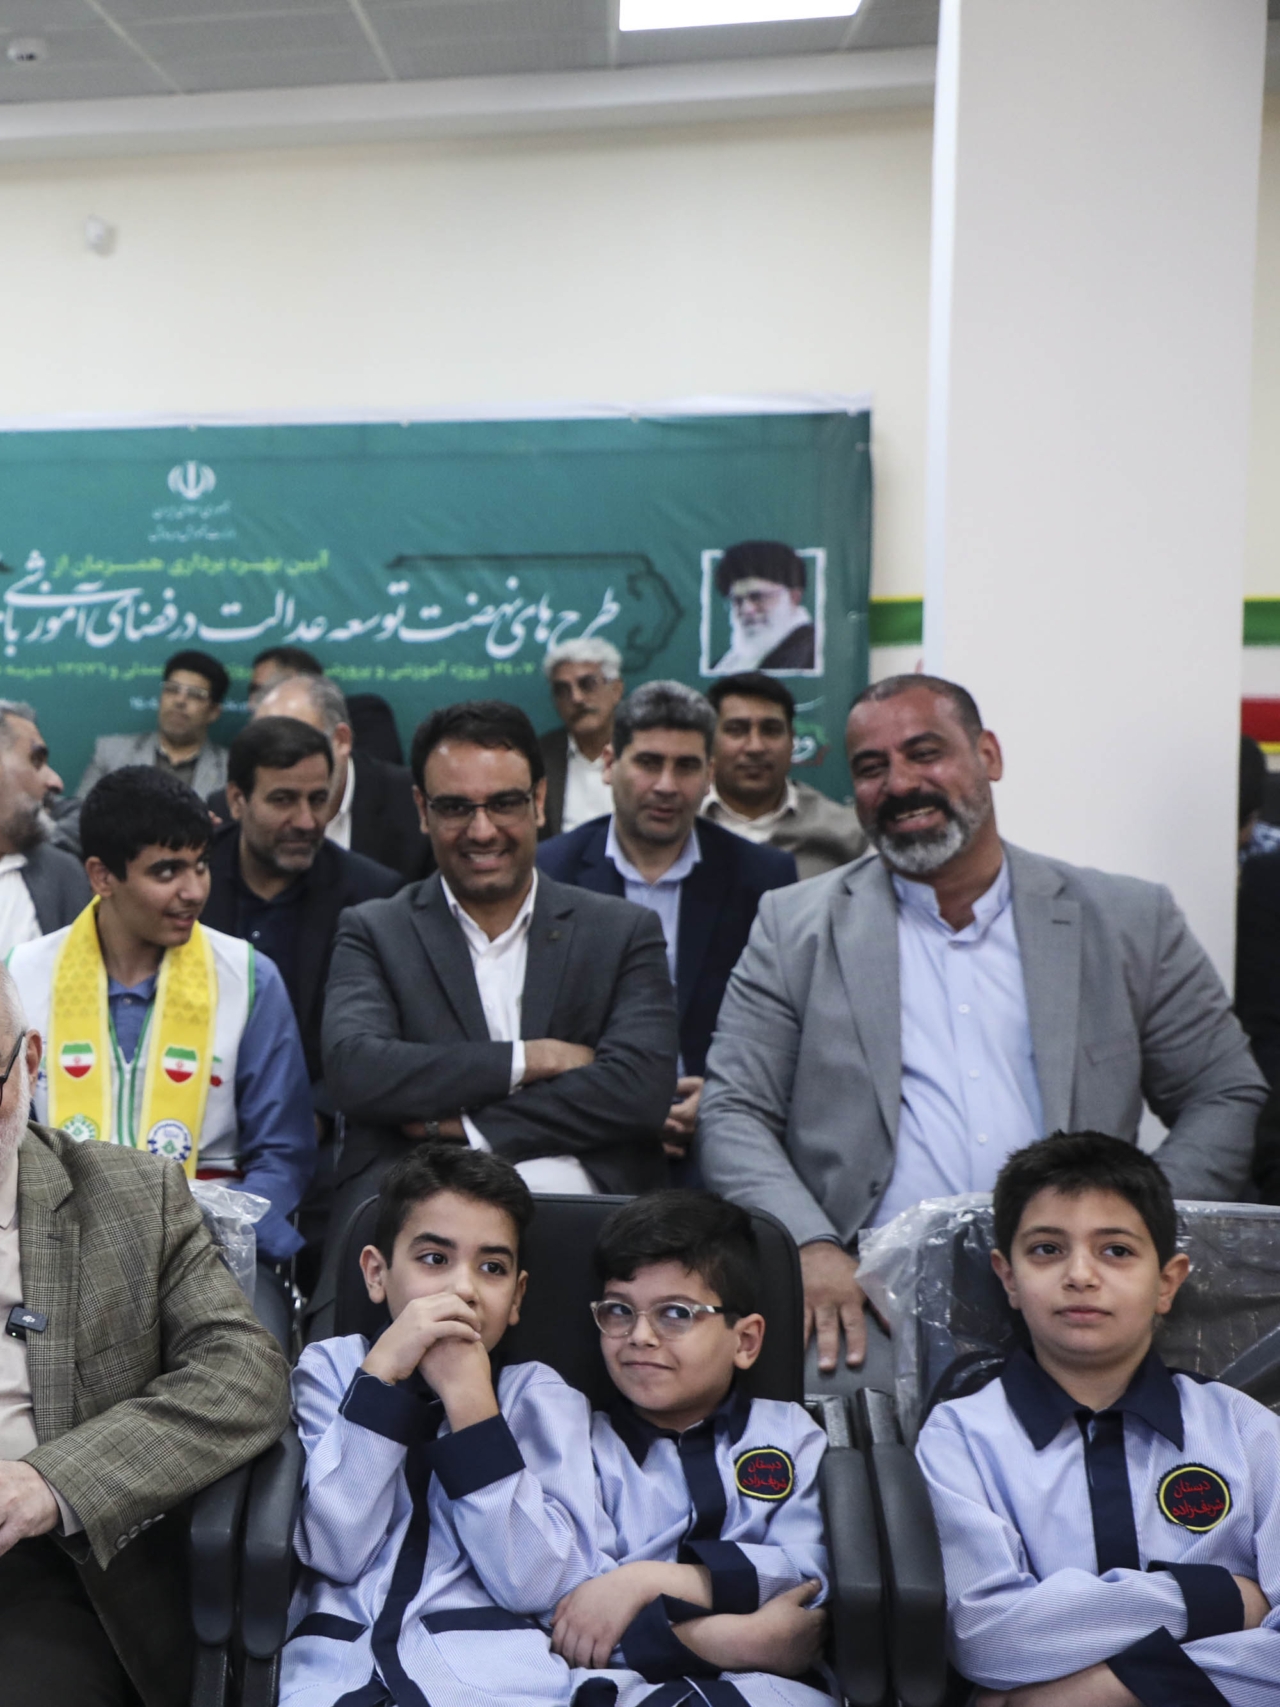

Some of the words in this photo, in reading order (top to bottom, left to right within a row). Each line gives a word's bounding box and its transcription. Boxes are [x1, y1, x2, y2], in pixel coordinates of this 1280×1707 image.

[3, 601, 19, 659] با
[85, 586, 178, 648] فضای
[166, 611, 198, 641] در
[197, 588, 328, 643] عدالت
[323, 579, 412, 643] توسعه
[397, 575, 524, 643] نهضت
